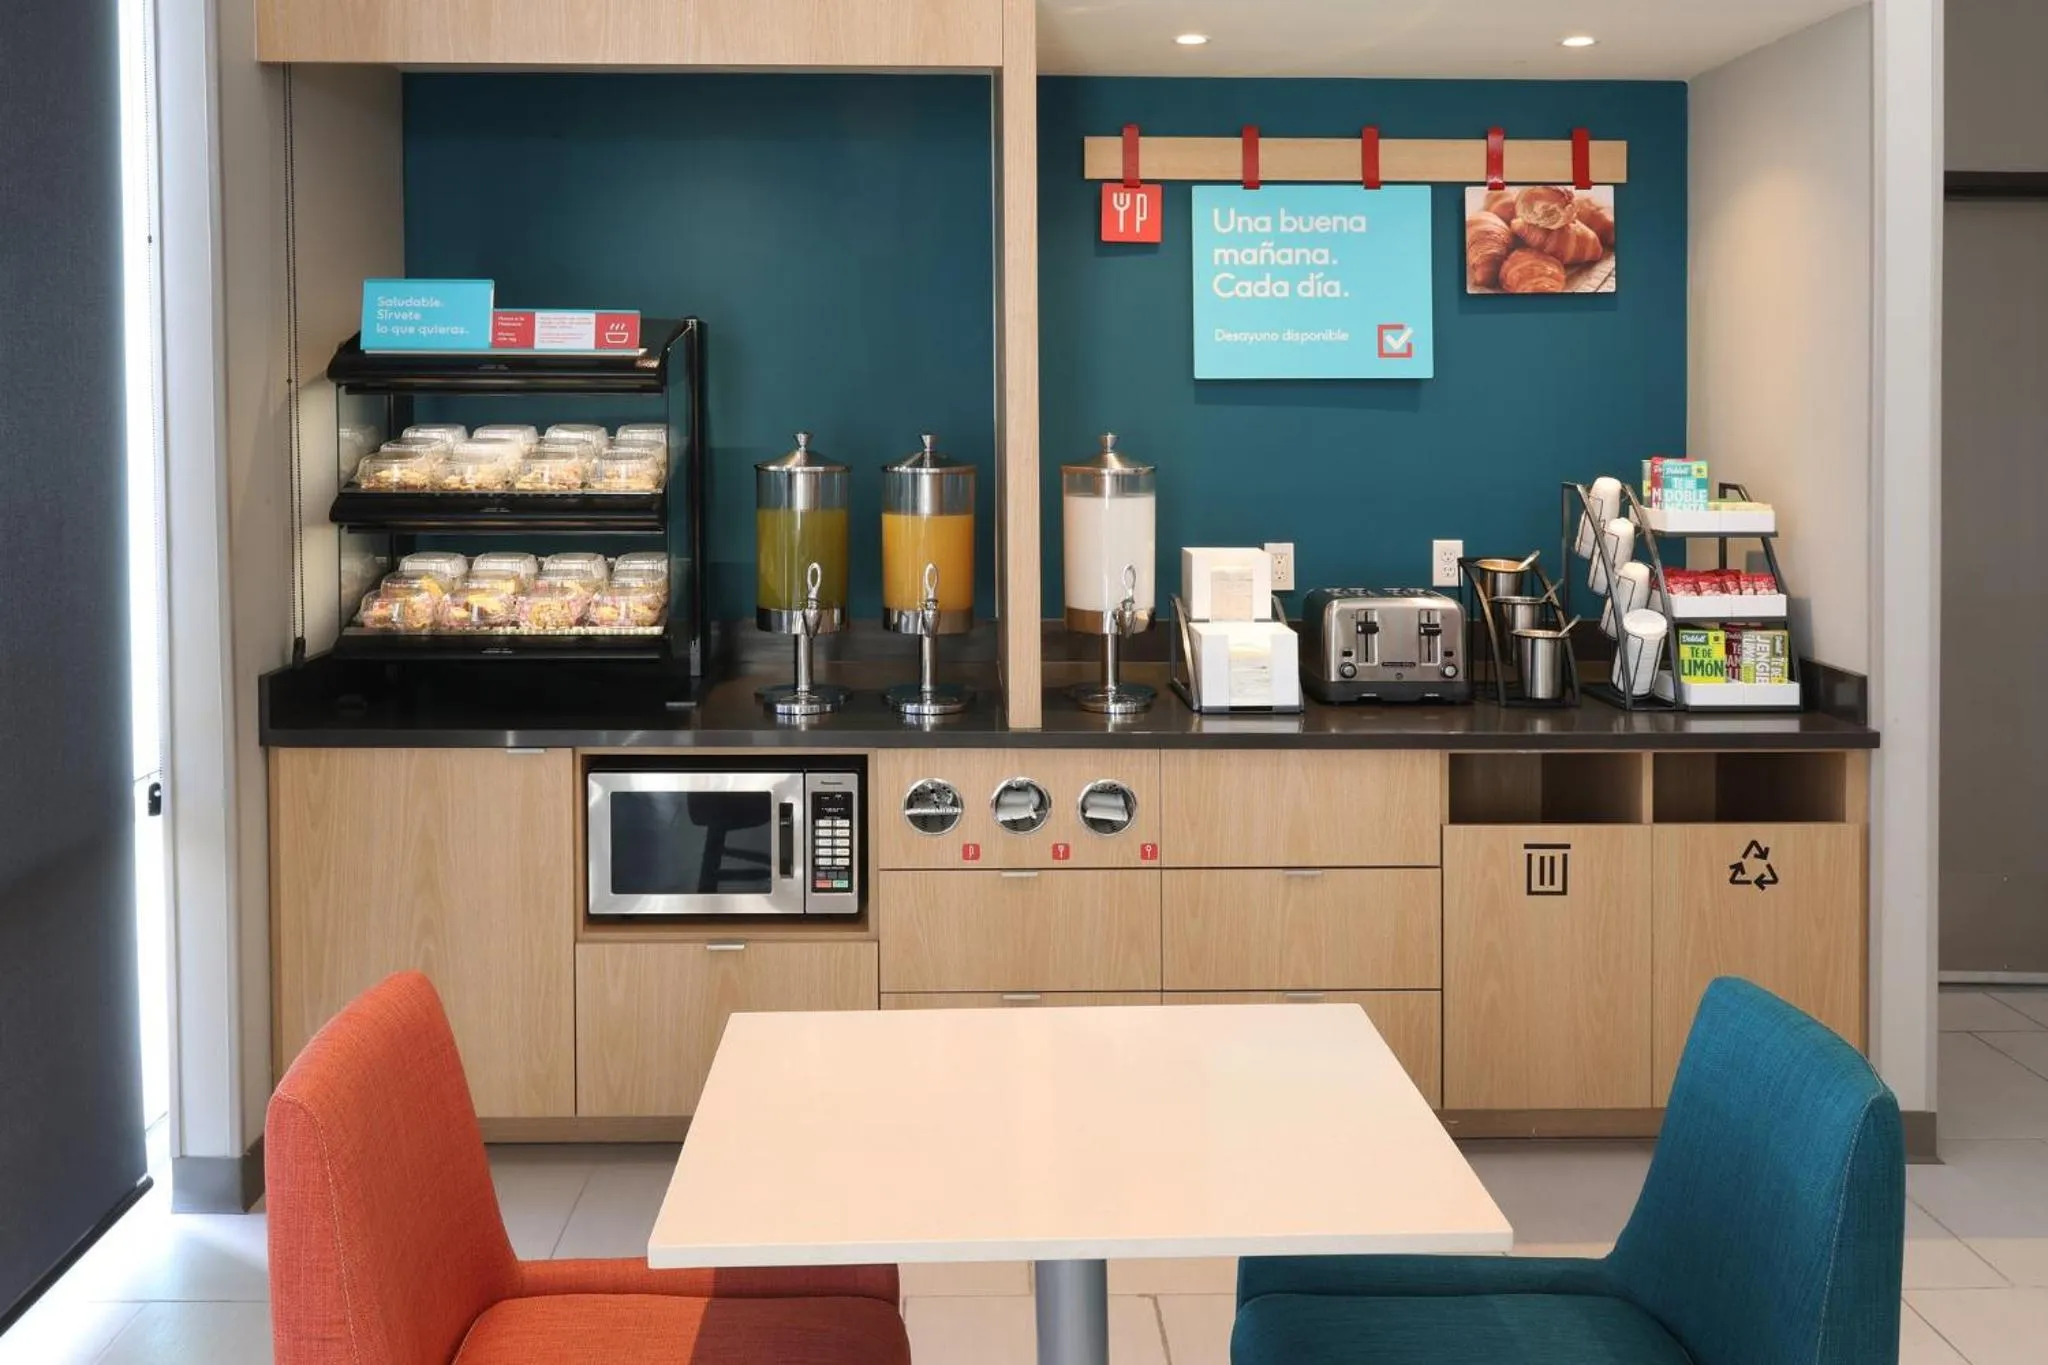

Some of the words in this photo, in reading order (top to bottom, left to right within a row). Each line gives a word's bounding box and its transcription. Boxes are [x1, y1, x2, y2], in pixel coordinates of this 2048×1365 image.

[1213, 208, 1271, 233] Una
[1280, 208, 1366, 233] buena
[1213, 240, 1339, 265] mañana.
[1213, 272, 1290, 298] Cada
[1297, 272, 1349, 298] día.
[377, 296, 444, 307] Saludable.
[376, 322, 388, 334] lo
[391, 326, 415, 337] que
[418, 324, 469, 337] quieras.
[1214, 329, 1279, 344] Desayuno
[1282, 328, 1349, 344] disponible
[1702, 647, 1712, 659] DE
[1681, 659, 1724, 677] LIMÓN
